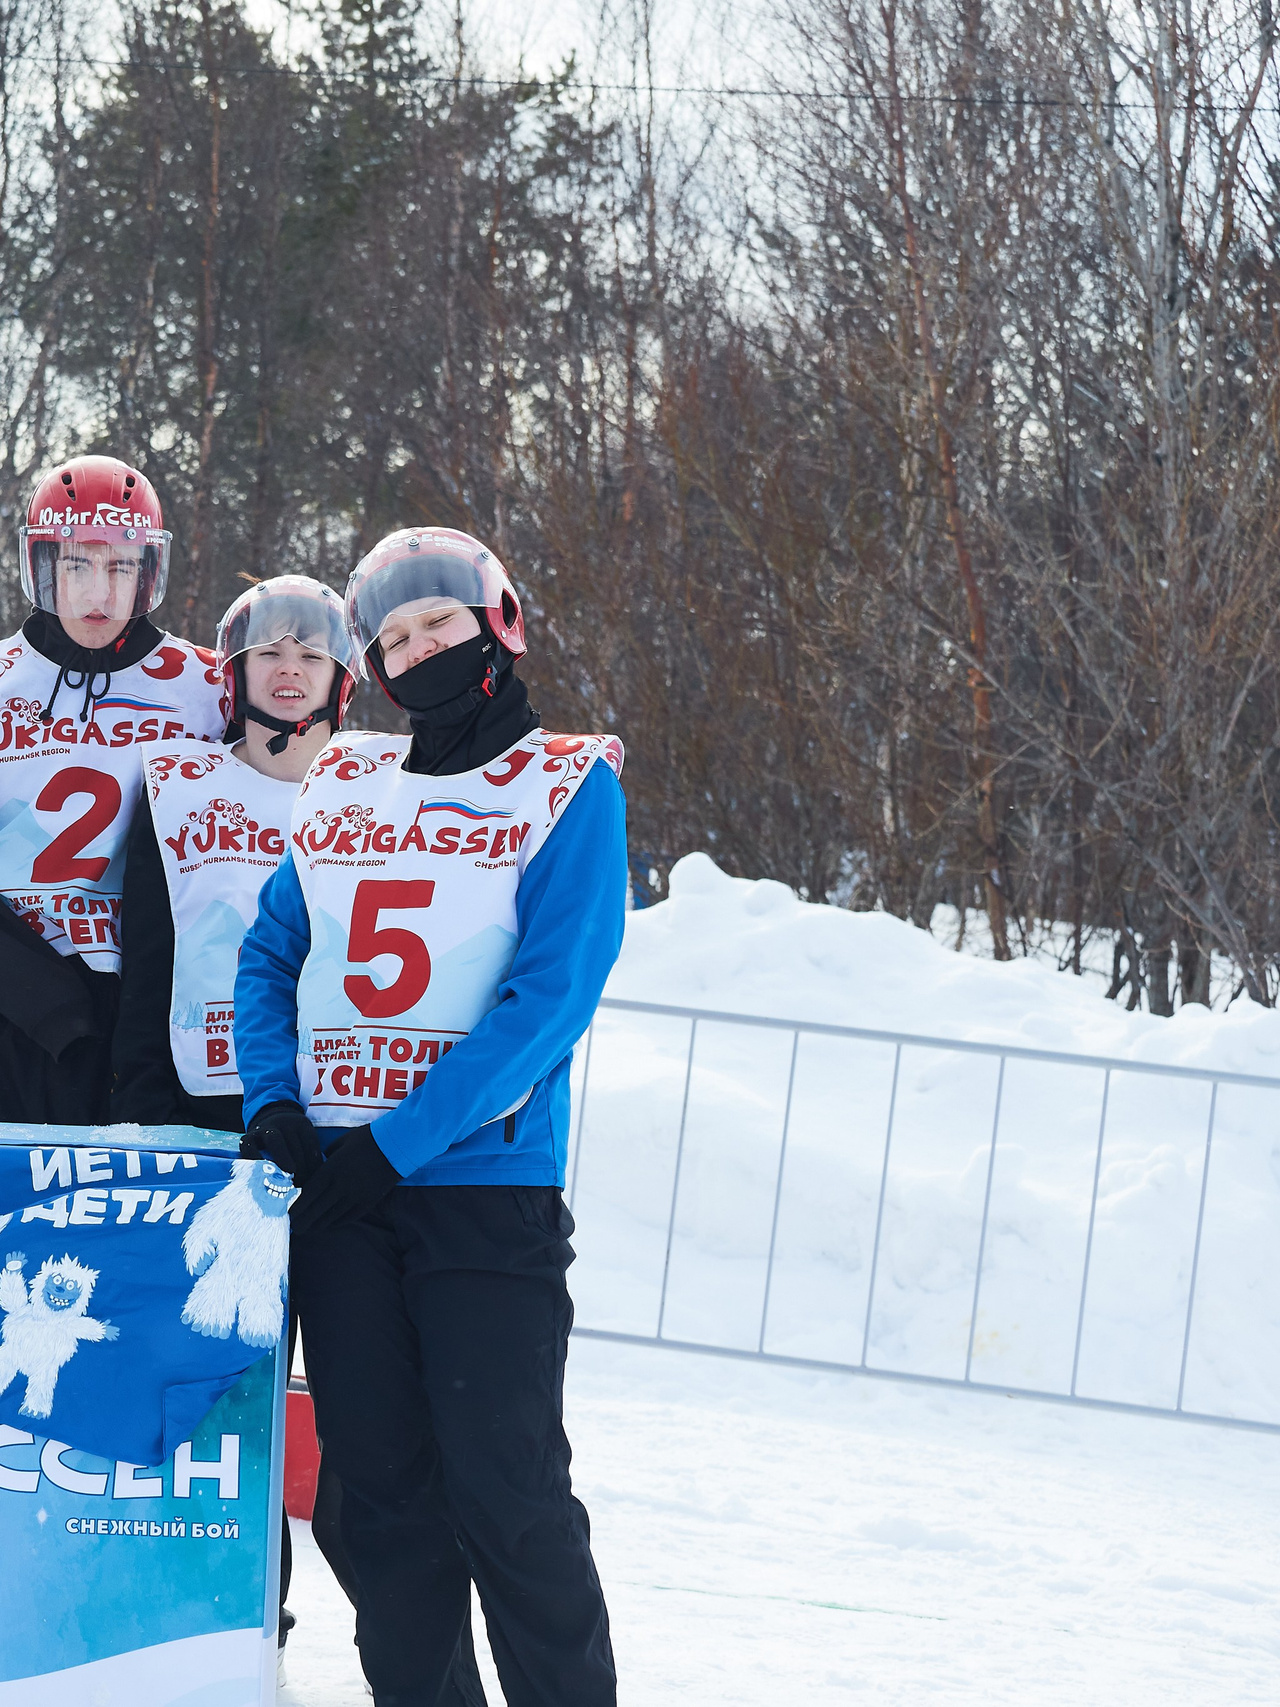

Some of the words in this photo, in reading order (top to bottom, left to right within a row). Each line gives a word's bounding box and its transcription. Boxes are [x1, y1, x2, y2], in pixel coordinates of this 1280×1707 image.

[41, 747, 71, 758] REGION
[31, 765, 123, 883] 2
[164, 812, 285, 862] YUKIG
[203, 856, 246, 866] MURMANSK
[247, 858, 278, 867] REGION
[356, 859, 386, 867] REGION
[343, 879, 436, 1019] 5
[205, 1010, 234, 1024] ДЛЯ
[205, 1024, 229, 1034] КТО
[206, 1038, 230, 1067] В
[65, 1516, 186, 1539] СНЕЖНЫЙ
[191, 1518, 240, 1539] БОЙ
